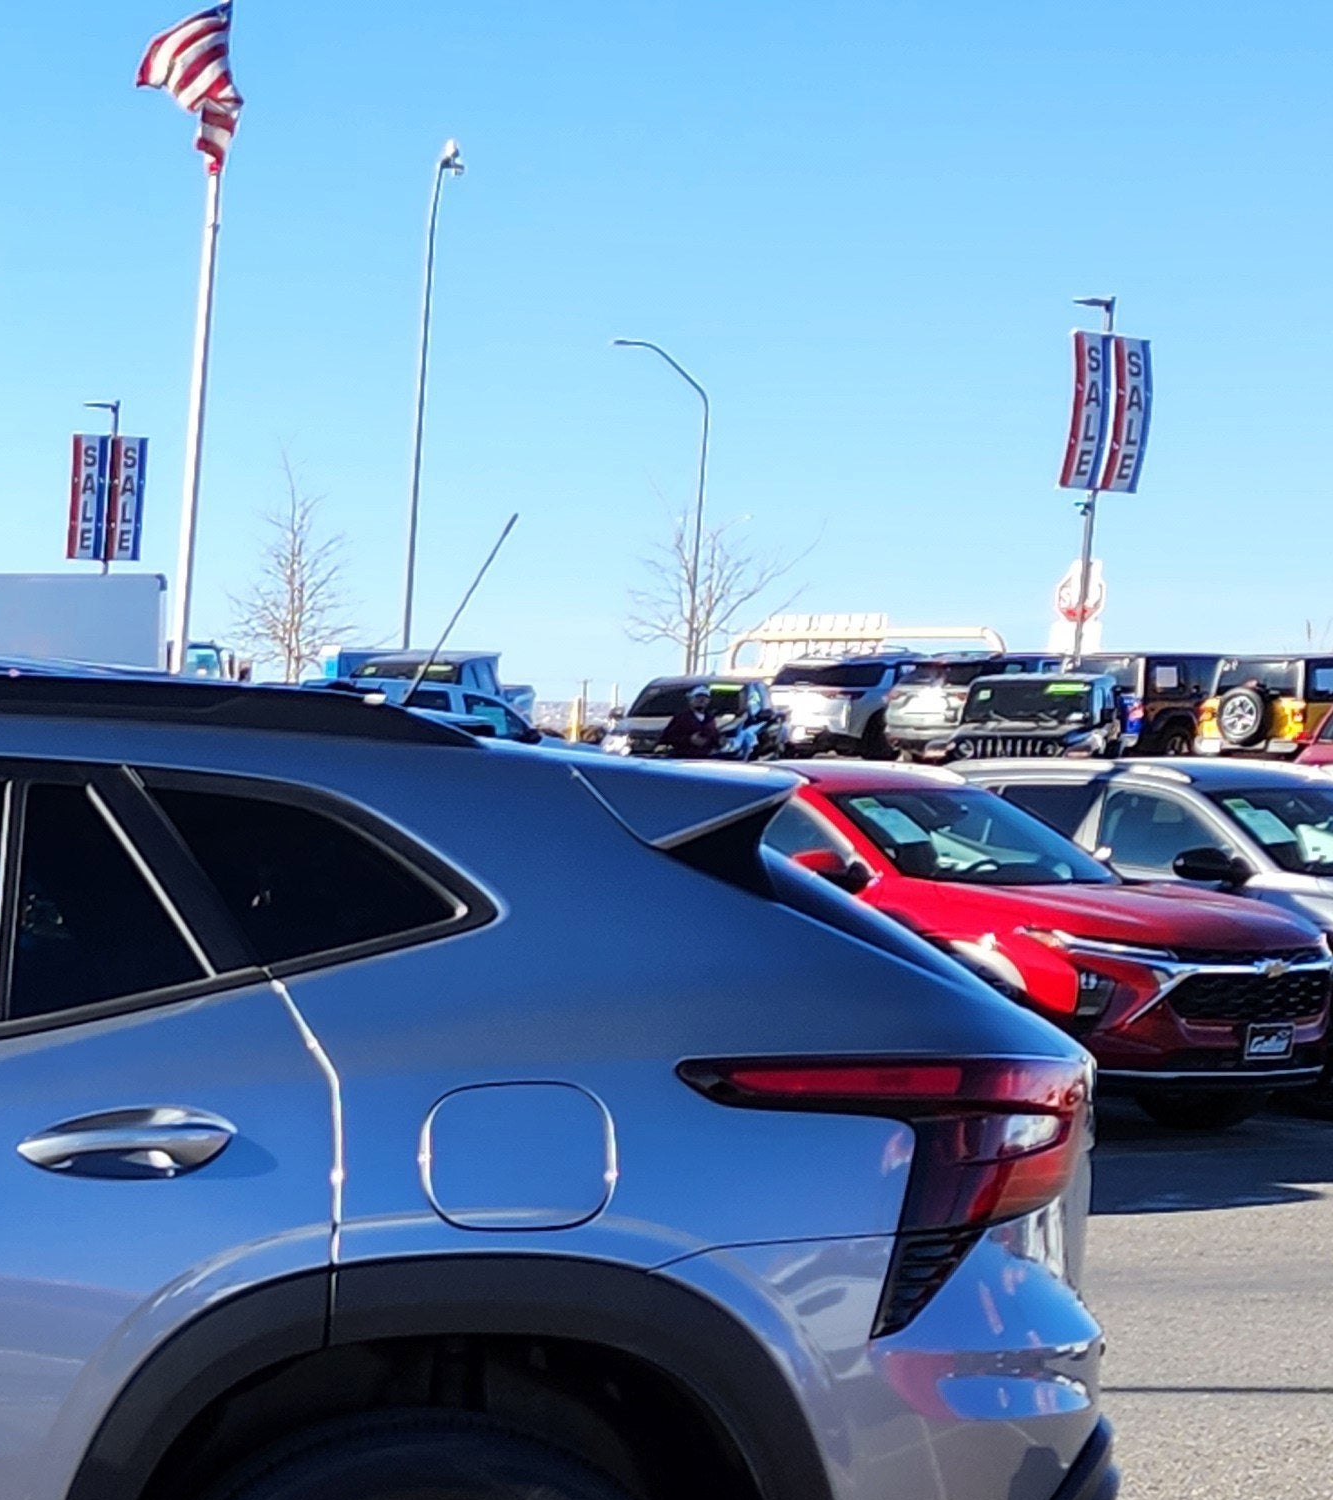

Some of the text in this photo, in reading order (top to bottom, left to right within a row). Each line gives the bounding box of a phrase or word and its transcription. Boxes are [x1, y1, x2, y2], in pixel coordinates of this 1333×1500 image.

[1075, 347, 1101, 476] SALE
[1117, 352, 1143, 480] SALE
[80, 446, 97, 550] SALE
[119, 447, 137, 551] SALE
